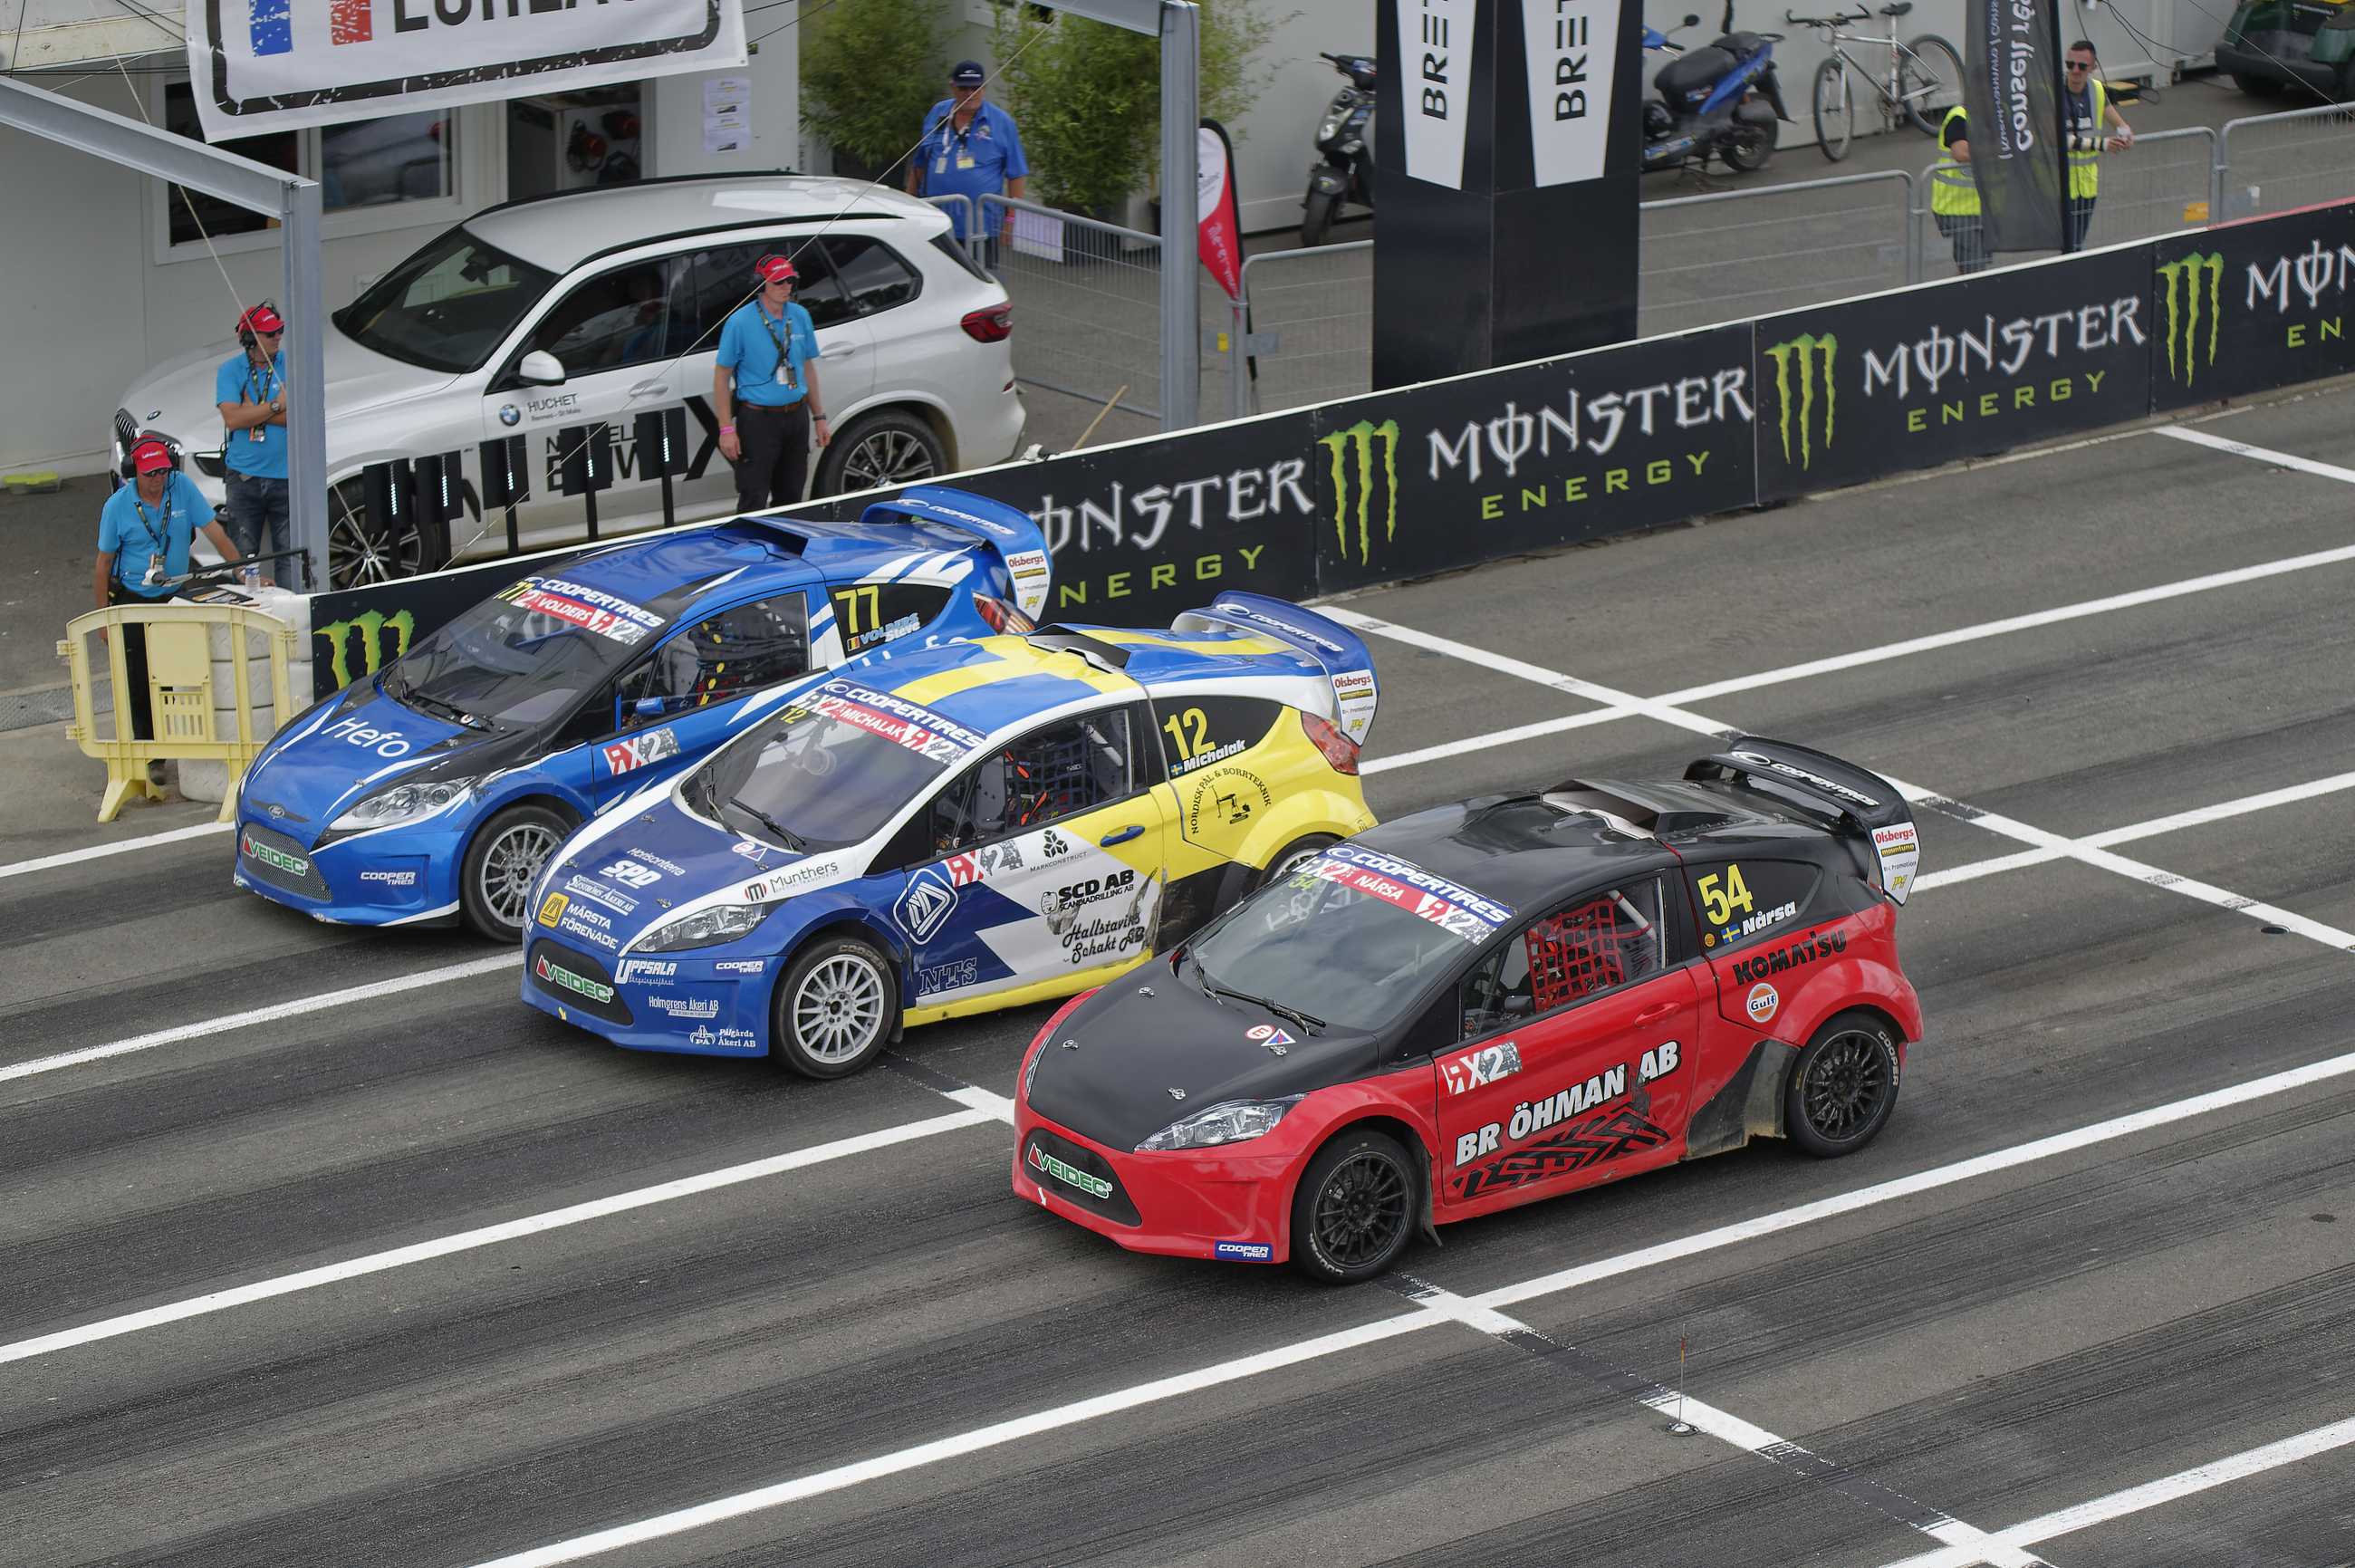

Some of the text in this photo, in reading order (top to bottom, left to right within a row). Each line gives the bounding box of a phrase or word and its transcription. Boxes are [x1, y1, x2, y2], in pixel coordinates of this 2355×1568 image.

[1421, 0, 1448, 120] BRE
[527, 393, 578, 412] HUCHET
[1908, 370, 2106, 432] ENERGY
[1481, 451, 1711, 520] ENERGY
[1029, 457, 1316, 555] ONSTER
[1008, 554, 1044, 569] Olsbergs
[1059, 544, 1265, 608] NERGY
[538, 597, 592, 622] VOLDERS
[834, 584, 880, 634] 77
[1334, 676, 1372, 689] Olsbergs
[780, 707, 808, 725] 12
[842, 707, 907, 741] MICHALAK
[1163, 707, 1217, 761] 12
[1182, 739, 1246, 773] Michalak
[1190, 789, 1205, 835] NORDISK
[1223, 767, 1273, 808] BORRTEKNIK
[1875, 828, 1915, 845] Olsbergs
[246, 836, 309, 877] VEIDEC
[360, 871, 417, 882] COOPER
[769, 861, 839, 893] Munthers
[1058, 869, 1134, 902] SCD AB
[1124, 883, 1134, 892] AB
[1354, 875, 1405, 900] NÅRSA
[1697, 864, 1754, 926] 54
[561, 916, 620, 949] FÖRENADE
[1742, 900, 1797, 936] Nårsa
[716, 960, 764, 971] COOPER
[839, 945, 886, 971] COOPER
[1072, 936, 1116, 964] Schakt
[1732, 928, 1848, 986] KOMATSU
[542, 960, 615, 1005] VEIDEC
[614, 959, 678, 985] UPPSALA
[919, 957, 977, 995] NTS
[649, 996, 719, 1012] Holmgrens Åkeri AB
[1750, 995, 1777, 1013] Gulf
[718, 1035, 756, 1049] Åkeri AB
[1878, 1030, 1899, 1087] COOPER
[1455, 1122, 1502, 1167] BR
[1507, 1063, 1627, 1140] ÖHMAN
[1637, 1041, 1679, 1082] AB
[1036, 1150, 1113, 1199] VEIDEC
[1218, 1244, 1269, 1254] COOPER
[1242, 1251, 1268, 1259] TIRES
